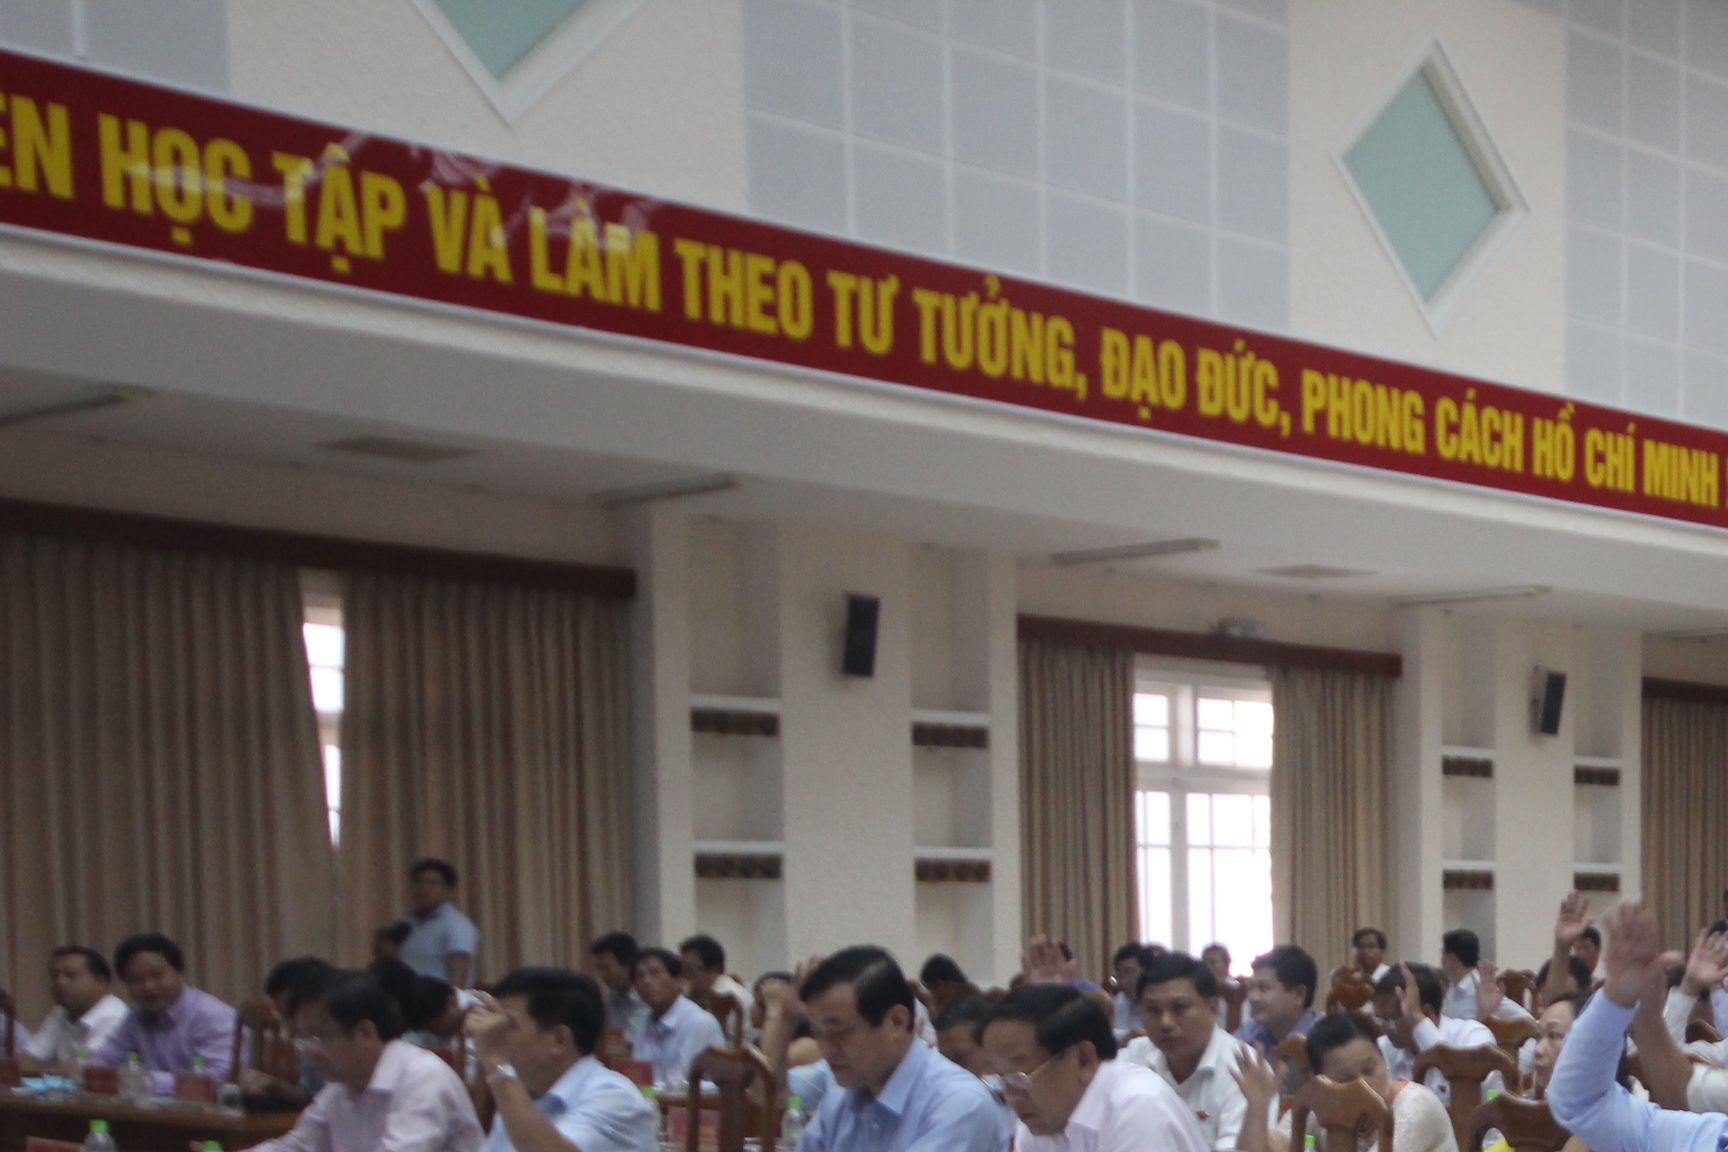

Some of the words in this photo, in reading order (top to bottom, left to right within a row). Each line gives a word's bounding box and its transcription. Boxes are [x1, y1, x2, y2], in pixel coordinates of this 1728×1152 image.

[98, 112, 254, 246] HỌC
[271, 141, 408, 273] TẬP
[425, 174, 513, 285] VÀ
[527, 194, 662, 313] LÀM
[673, 236, 813, 342] THEO
[826, 269, 899, 356] TƯ
[912, 274, 1088, 402] TƯỞNG,
[1100, 326, 1188, 420] ĐẠO
[1195, 338, 1291, 438] ĐỨC,
[1302, 368, 1426, 456] PHONG
[1434, 388, 1525, 473] CÁCH
[1532, 401, 1576, 482] HỒ
[1584, 422, 1636, 493] CHÍ
[1642, 438, 1720, 508] MINH
